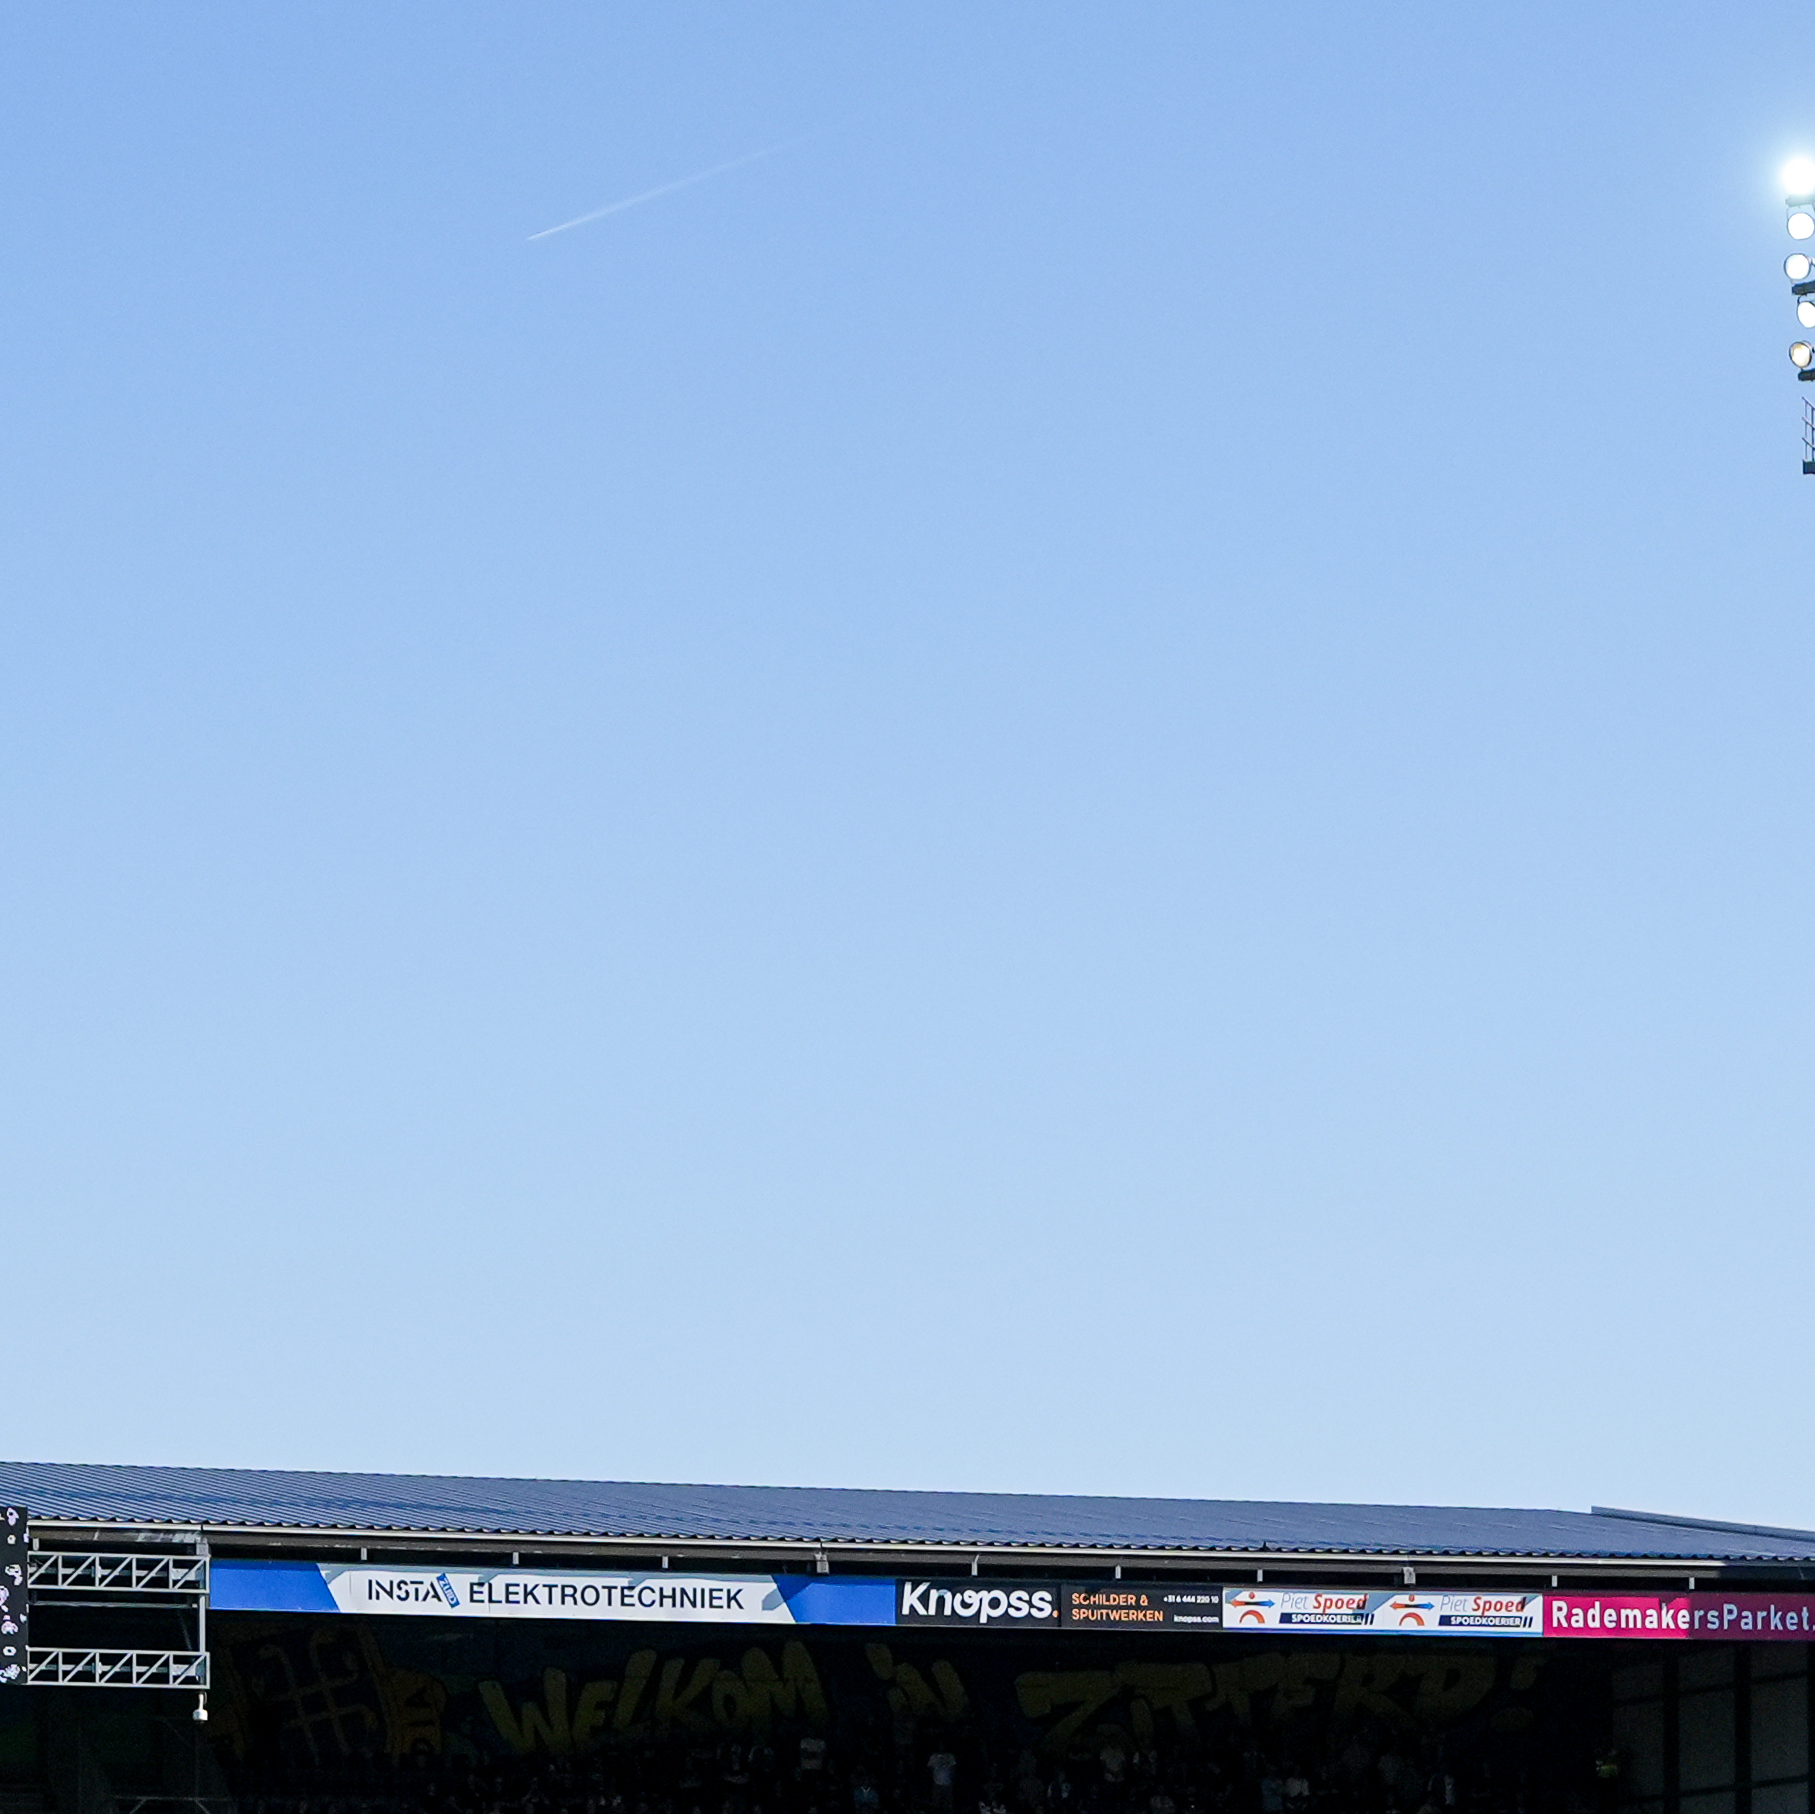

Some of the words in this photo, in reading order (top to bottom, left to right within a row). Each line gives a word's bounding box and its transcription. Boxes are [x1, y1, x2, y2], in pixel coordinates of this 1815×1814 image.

[367, 1578, 444, 1603] INSTA
[469, 1582, 745, 1610] ELEKTROTECHNIEK
[1071, 1593, 1133, 1606] SCHILDER
[1135, 1594, 1149, 1606] &
[1280, 1592, 1309, 1609] Piet
[1312, 1593, 1369, 1613] Spoed
[1440, 1595, 1468, 1612] Piet
[1471, 1596, 1527, 1615] Spoed
[1071, 1608, 1164, 1622] SPUITWERKEN
[1450, 1615, 1521, 1626] SPOEDKOERIER
